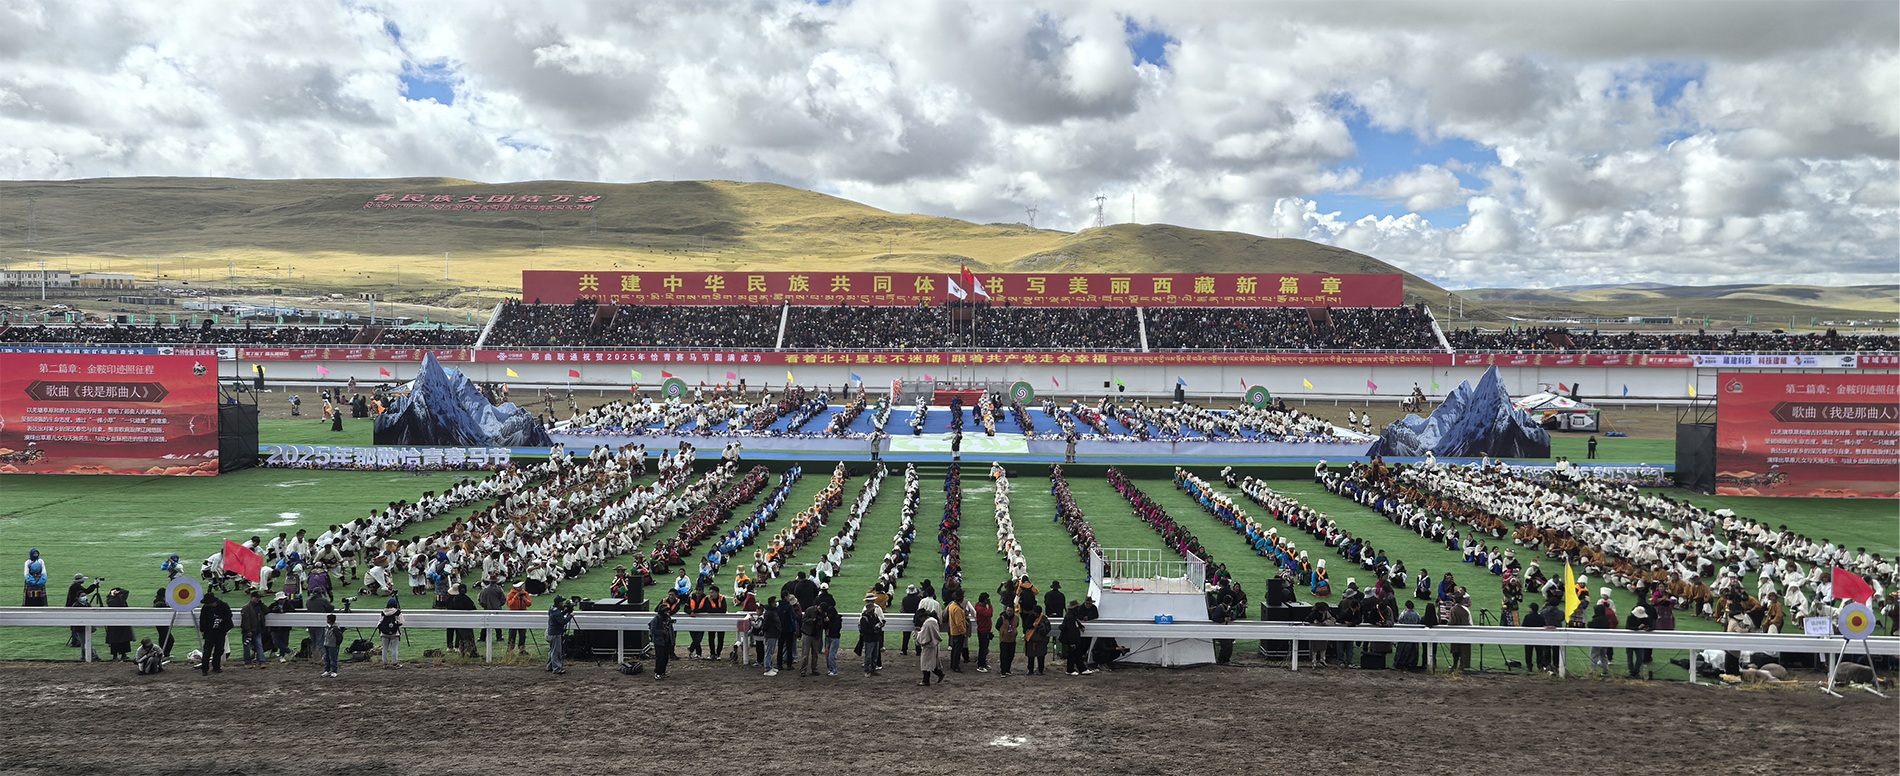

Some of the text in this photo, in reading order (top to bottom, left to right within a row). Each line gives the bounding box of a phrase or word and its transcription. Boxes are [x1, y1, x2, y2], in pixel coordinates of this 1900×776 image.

[373, 193, 602, 203] 各民族大团结万岁
[579, 274, 1342, 295] 共建中华民族共同体 书写美丽西藏新篇章
[531, 353, 762, 363] 那曲联通祝贺2025年恰青赛马节圆满成功
[785, 353, 1107, 364] 看着北斗星走不迷路 跟着共产党走会幸福
[46, 385, 149, 398] 歌曲《我是那曲人》
[266, 445, 512, 466] 2025年那曲恰青赛马节
